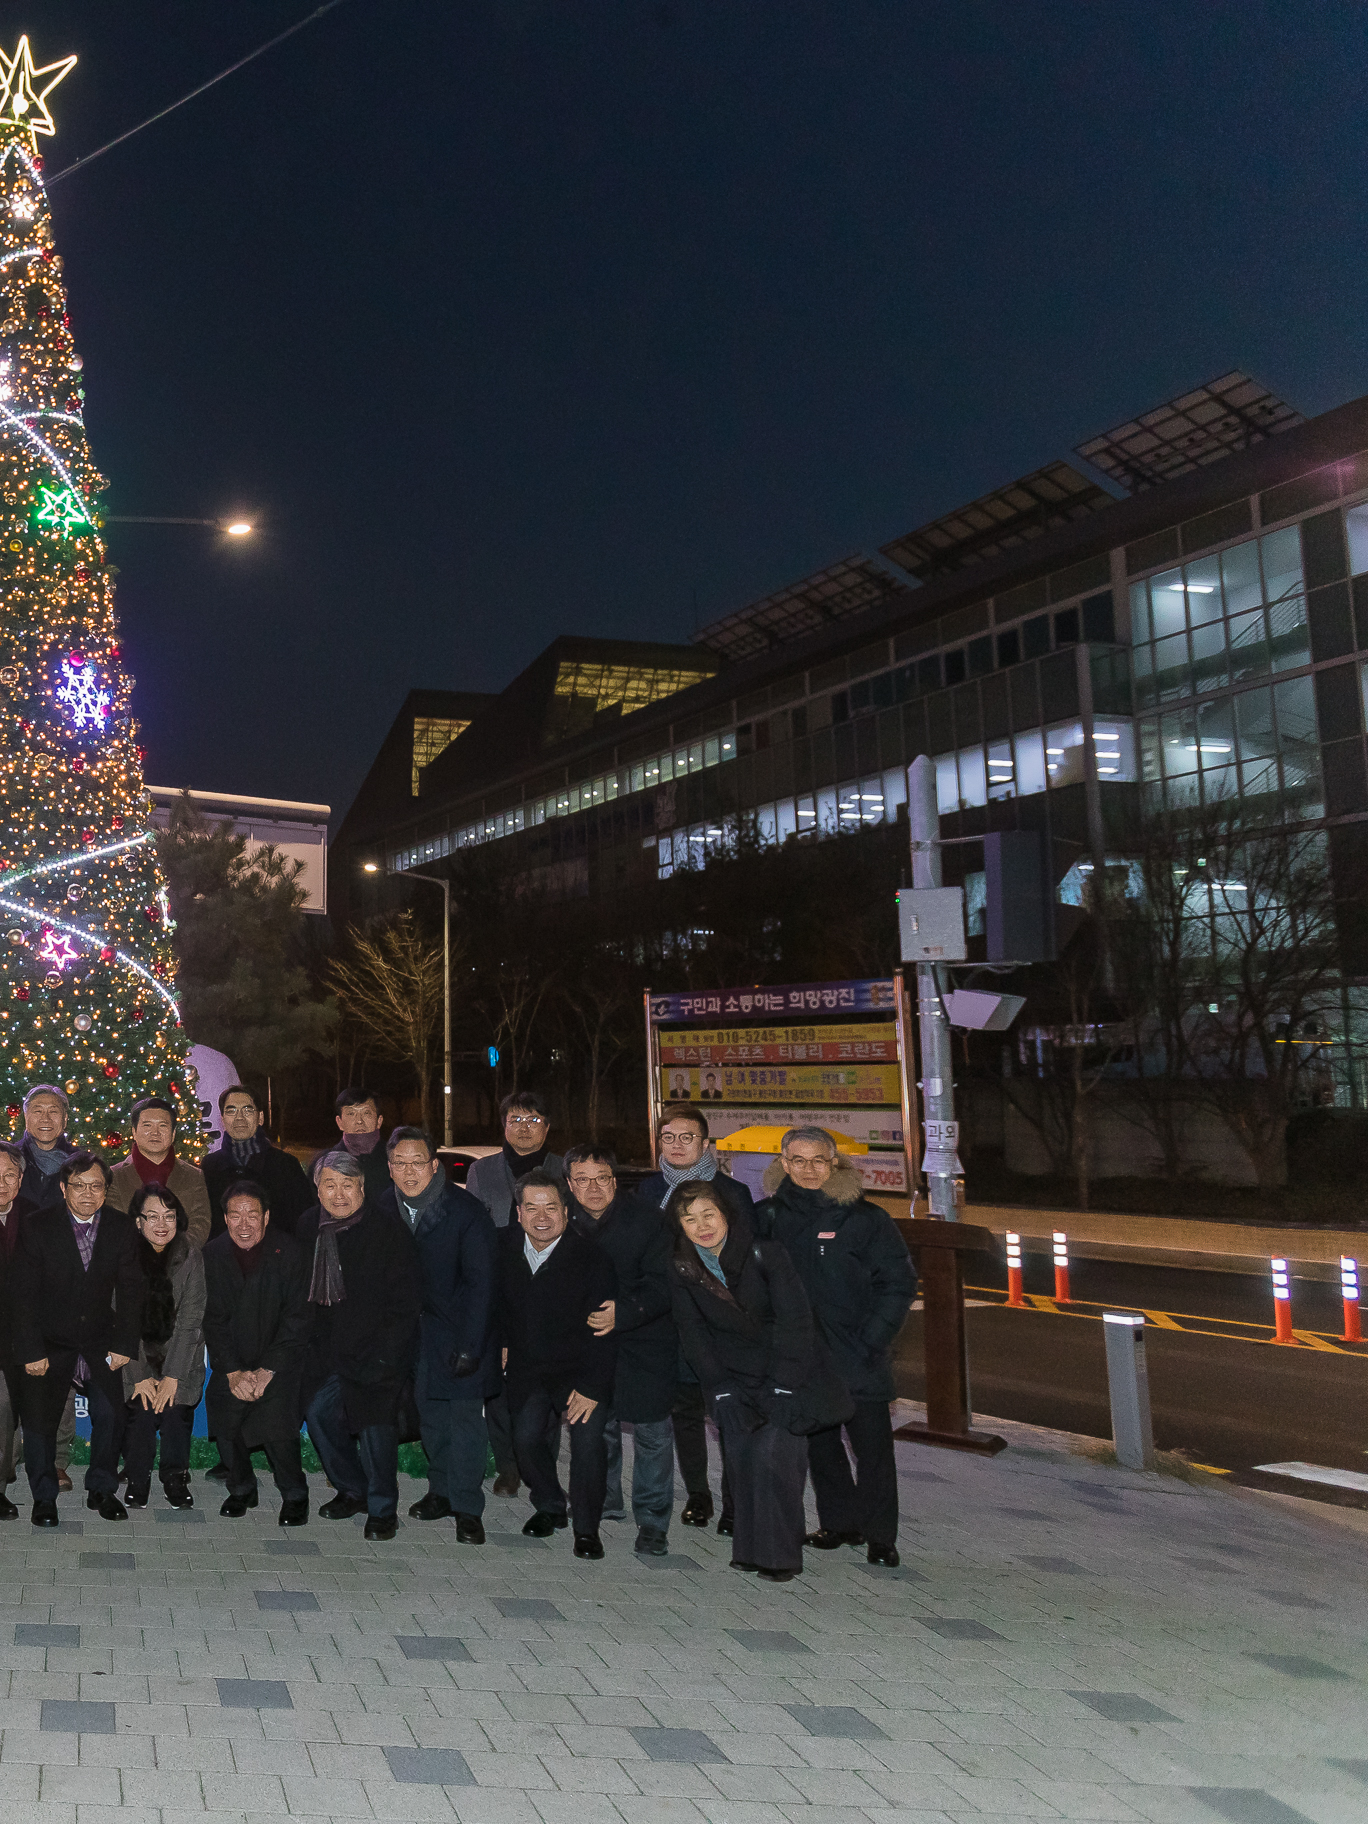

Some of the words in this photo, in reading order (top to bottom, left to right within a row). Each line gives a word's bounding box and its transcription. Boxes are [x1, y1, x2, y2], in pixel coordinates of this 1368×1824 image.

[679, 996, 721, 1015] 구민과
[725, 993, 784, 1014] 소통하는
[788, 987, 856, 1009] 희망광진
[717, 1028, 816, 1044] 010-5245-1859
[673, 1046, 712, 1062] 렉스턴
[723, 1045, 765, 1060] 스포츠
[778, 1044, 823, 1060] 티볼리
[837, 1041, 887, 1059] 코란도
